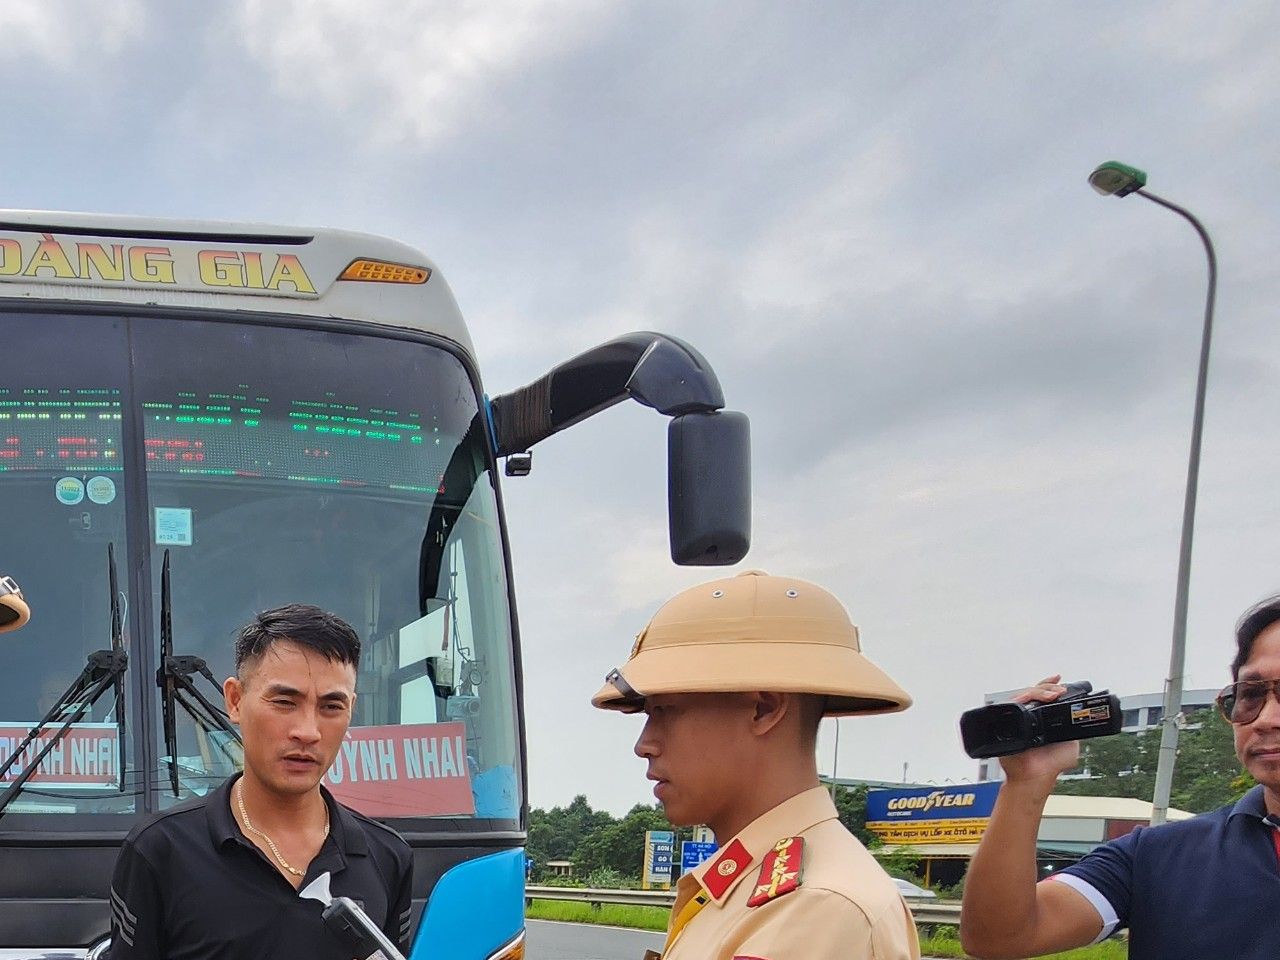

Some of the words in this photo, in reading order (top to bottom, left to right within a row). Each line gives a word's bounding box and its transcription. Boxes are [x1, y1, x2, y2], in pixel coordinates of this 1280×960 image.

[198, 249, 318, 294] GIA
[321, 731, 398, 784] UỲNH
[403, 736, 465, 779] NHAI
